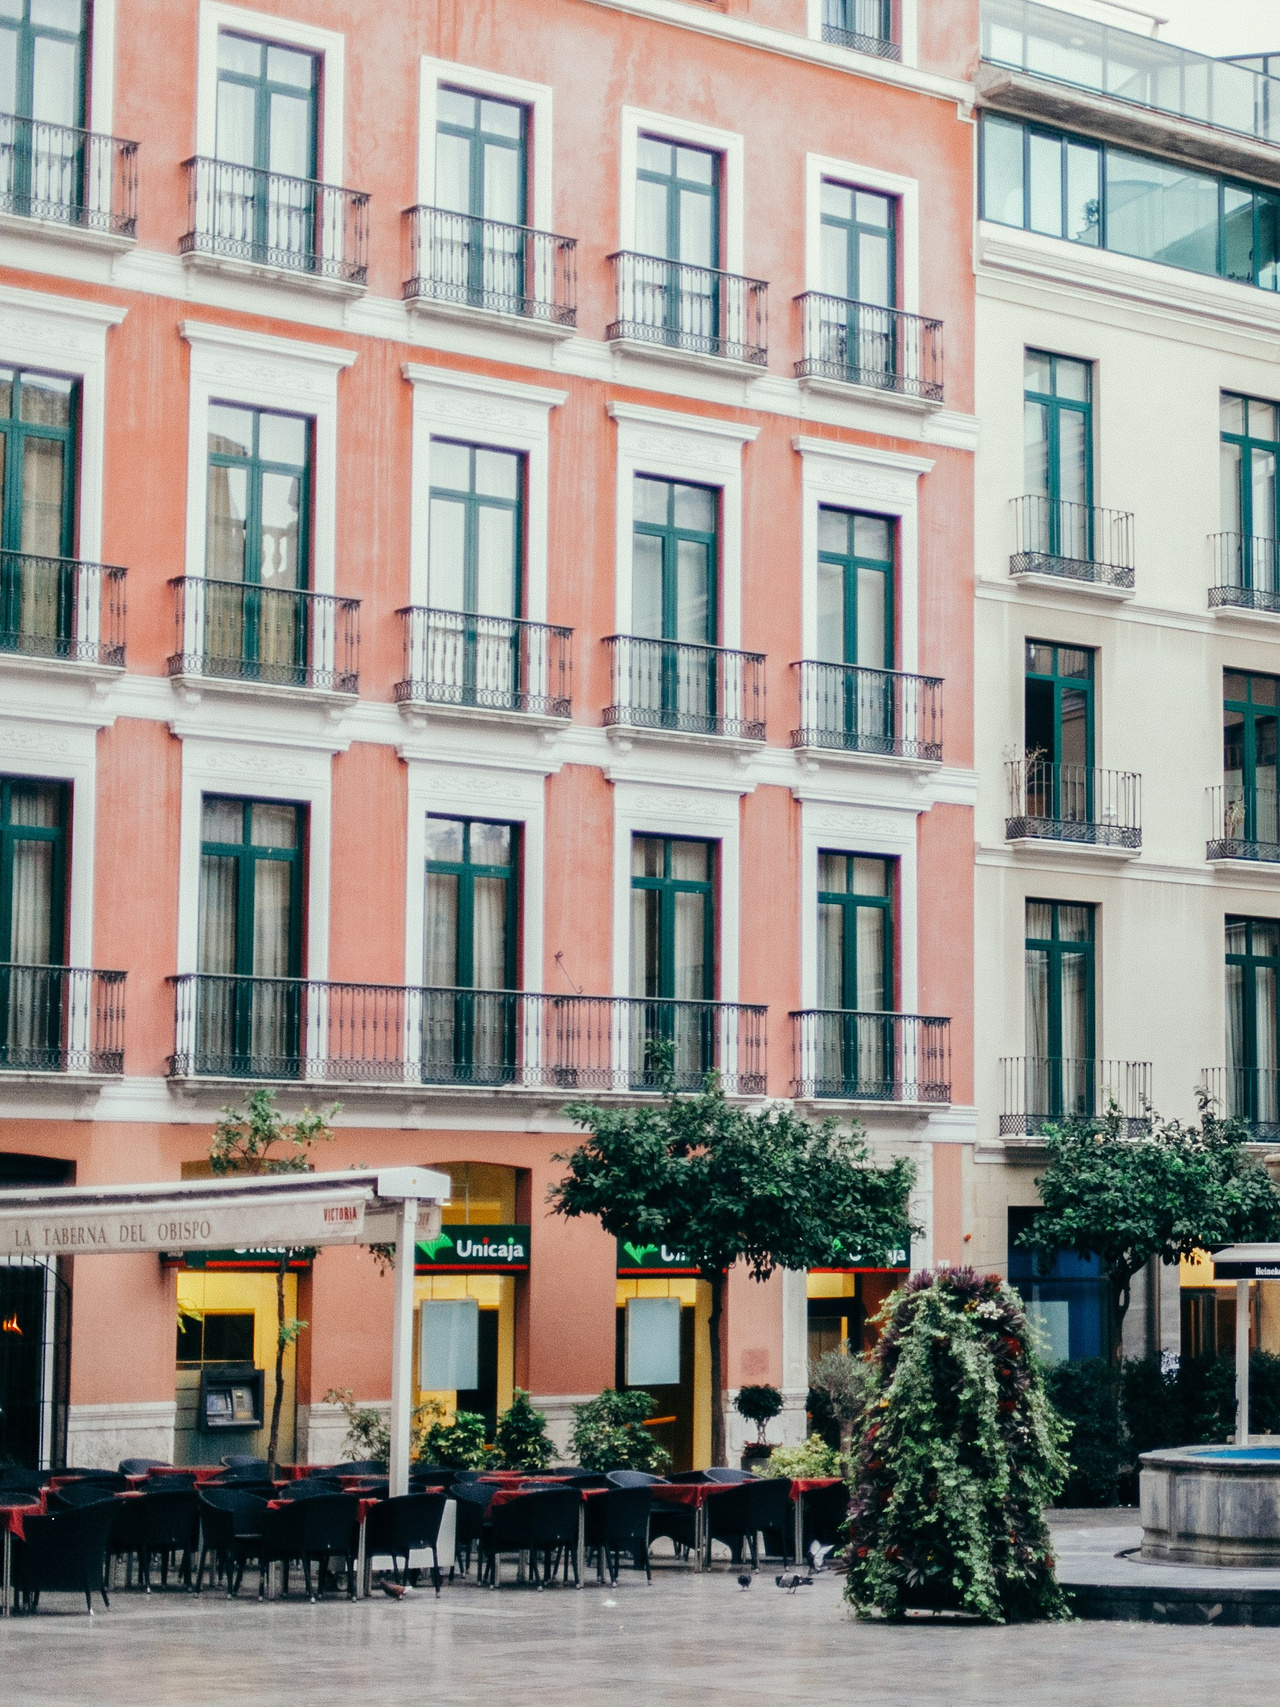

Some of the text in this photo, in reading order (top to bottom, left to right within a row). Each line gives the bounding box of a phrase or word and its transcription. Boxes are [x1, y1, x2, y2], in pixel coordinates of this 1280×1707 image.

[323, 1206, 357, 1222] VICTORIA
[15, 1220, 211, 1247] LA TABERNA DEL OBISPO
[456, 1237, 524, 1261] Unicaja
